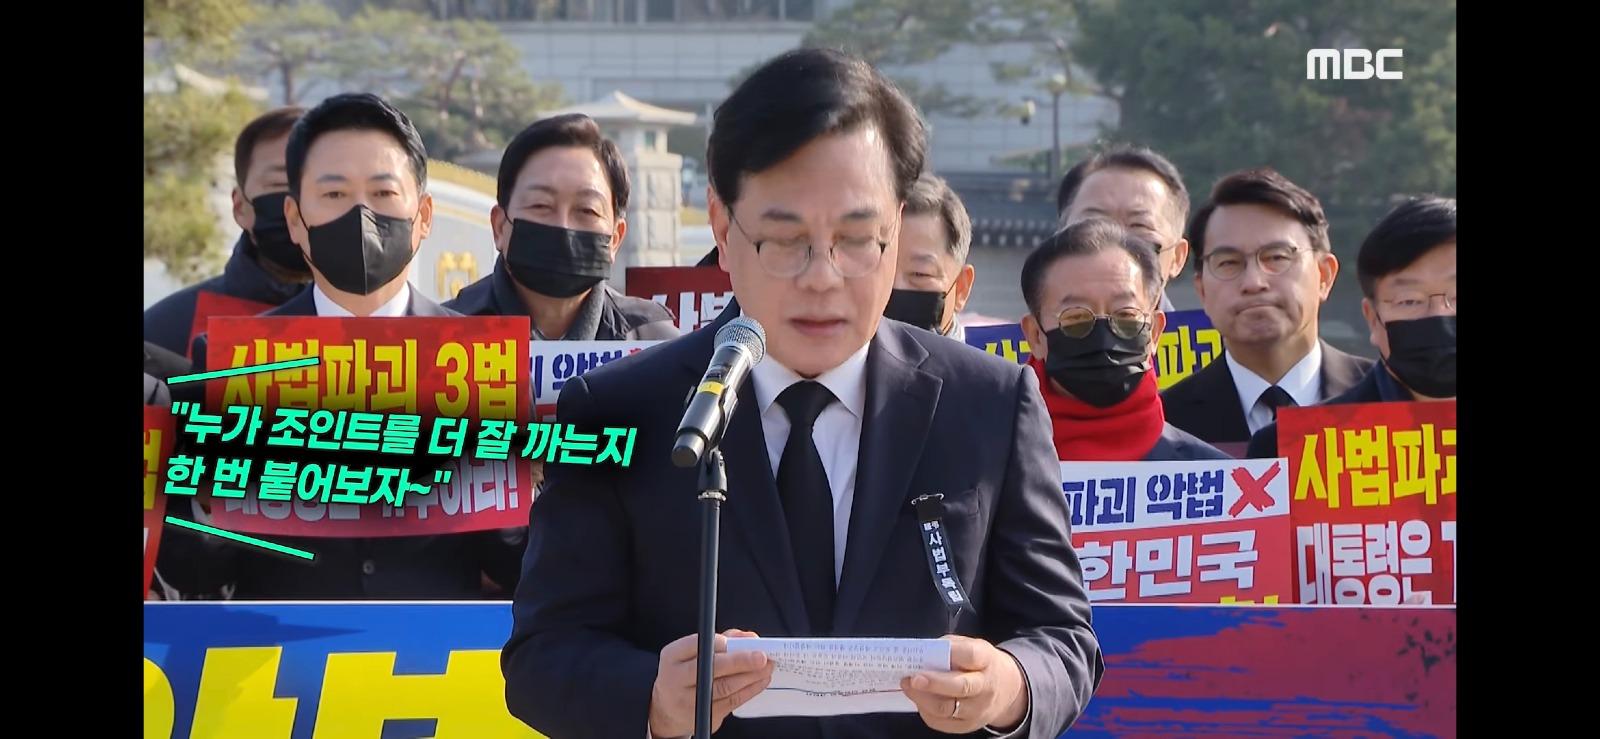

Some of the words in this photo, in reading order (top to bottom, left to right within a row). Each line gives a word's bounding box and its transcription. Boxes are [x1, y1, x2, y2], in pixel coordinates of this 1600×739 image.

[220, 338, 418, 420] 사법파괴
[434, 341, 470, 417] 3
[472, 338, 518, 419] 법
[1146, 469, 1225, 521] 악법
